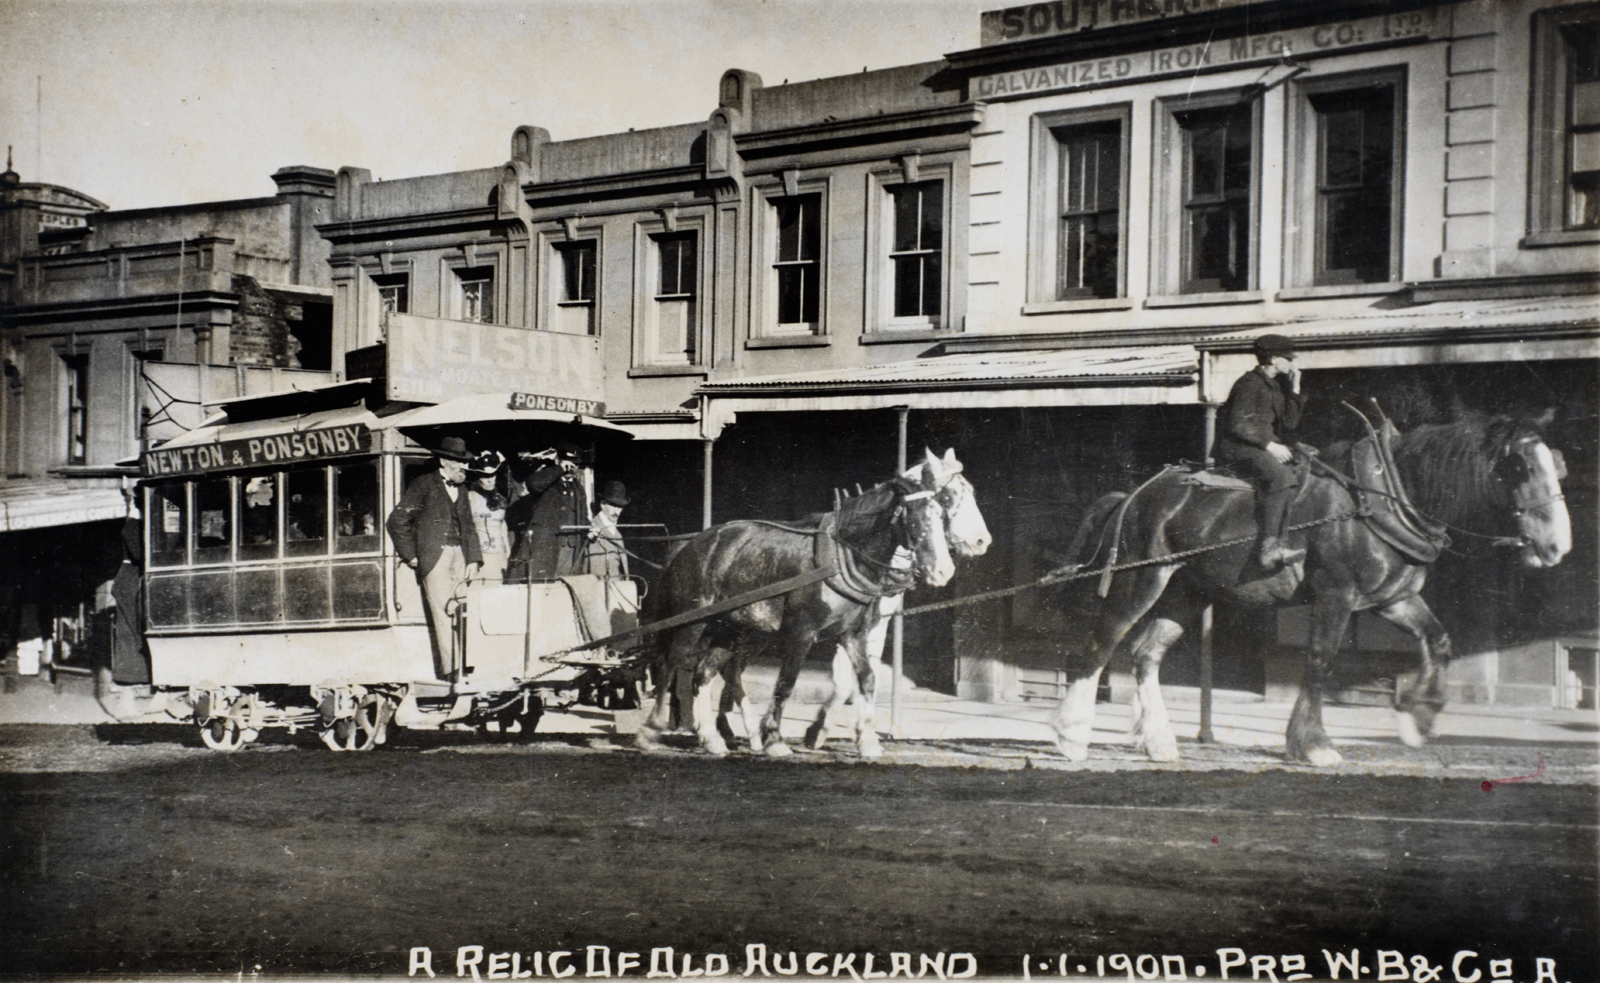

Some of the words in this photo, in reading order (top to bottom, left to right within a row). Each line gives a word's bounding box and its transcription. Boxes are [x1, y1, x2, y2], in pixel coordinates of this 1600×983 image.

[978, 57, 1132, 96] GALVANIZED
[1150, 46, 1212, 73] IRON
[401, 316, 591, 391] NELSON
[515, 393, 598, 414] PONSONBY
[145, 444, 225, 475] NEWTON
[232, 449, 244, 466] &
[250, 426, 363, 462] PONSONBY
